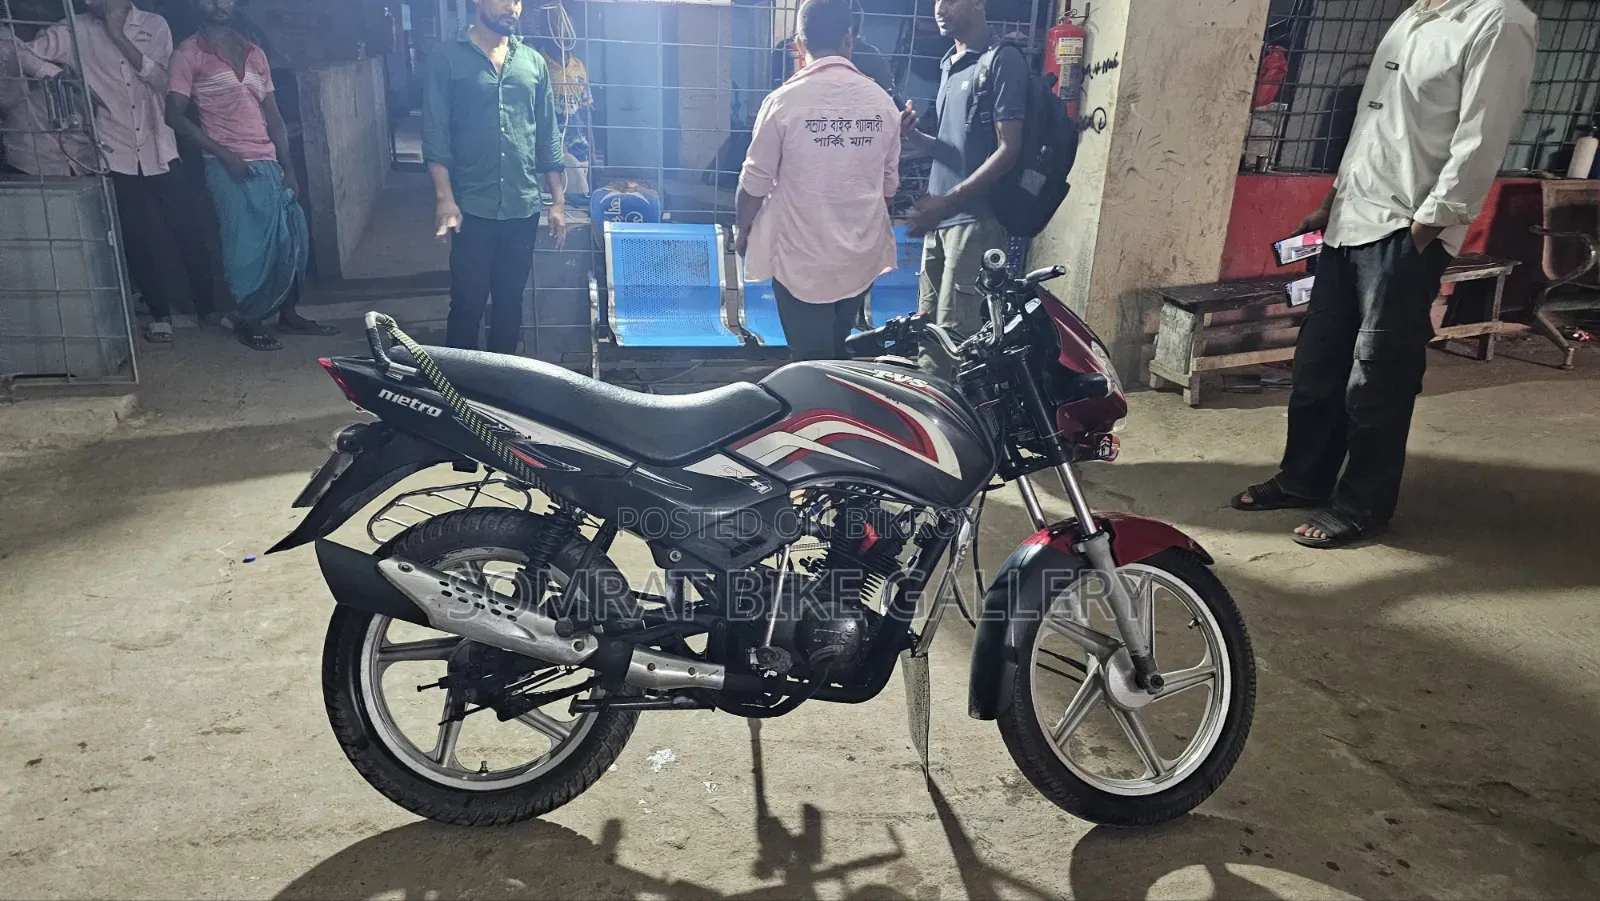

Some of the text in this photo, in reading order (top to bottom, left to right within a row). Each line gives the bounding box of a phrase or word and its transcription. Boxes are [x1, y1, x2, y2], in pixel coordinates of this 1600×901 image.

[830, 117, 853, 133] বাইক
[856, 115, 883, 133] গ্যালারী
[813, 134, 874, 148] পার্কিং ম্যান
[378, 389, 443, 418] metro
